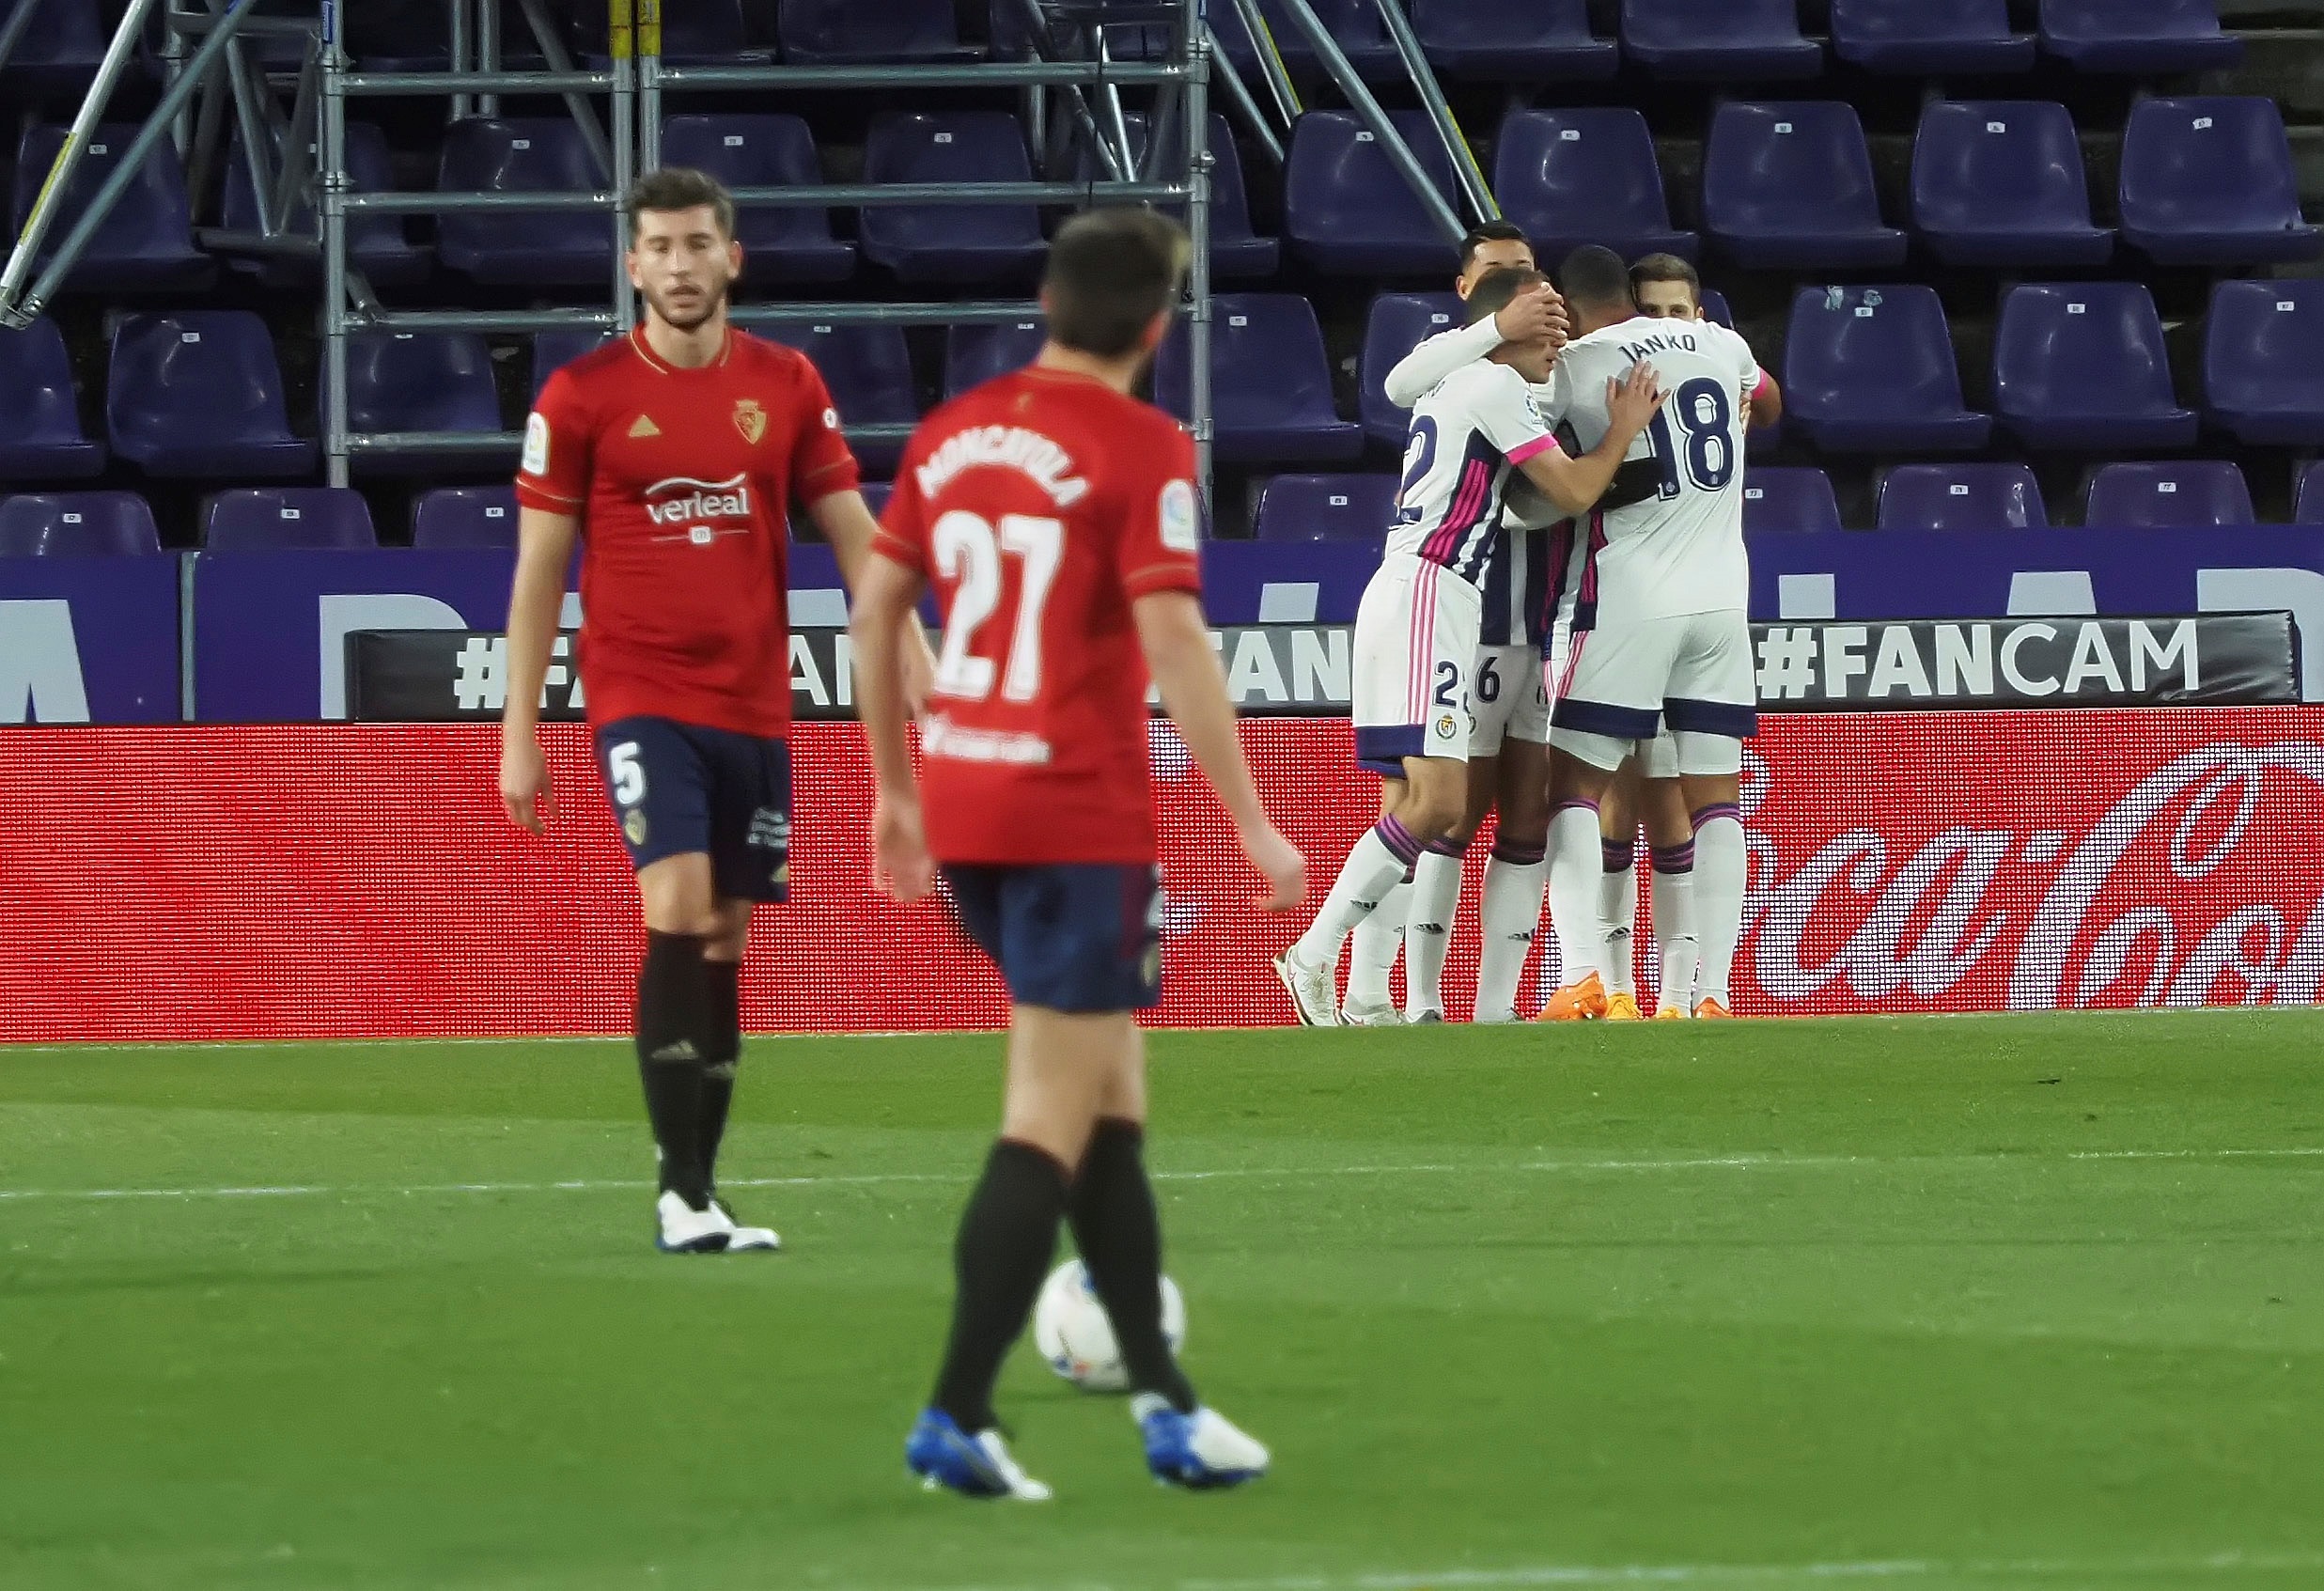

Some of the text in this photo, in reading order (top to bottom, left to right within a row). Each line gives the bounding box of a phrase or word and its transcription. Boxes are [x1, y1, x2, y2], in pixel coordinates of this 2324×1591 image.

[1646, 378, 1735, 502] 18
[931, 509, 1066, 703] 27
[1755, 619, 2199, 699] #FANCAM
[610, 741, 645, 805] 5
